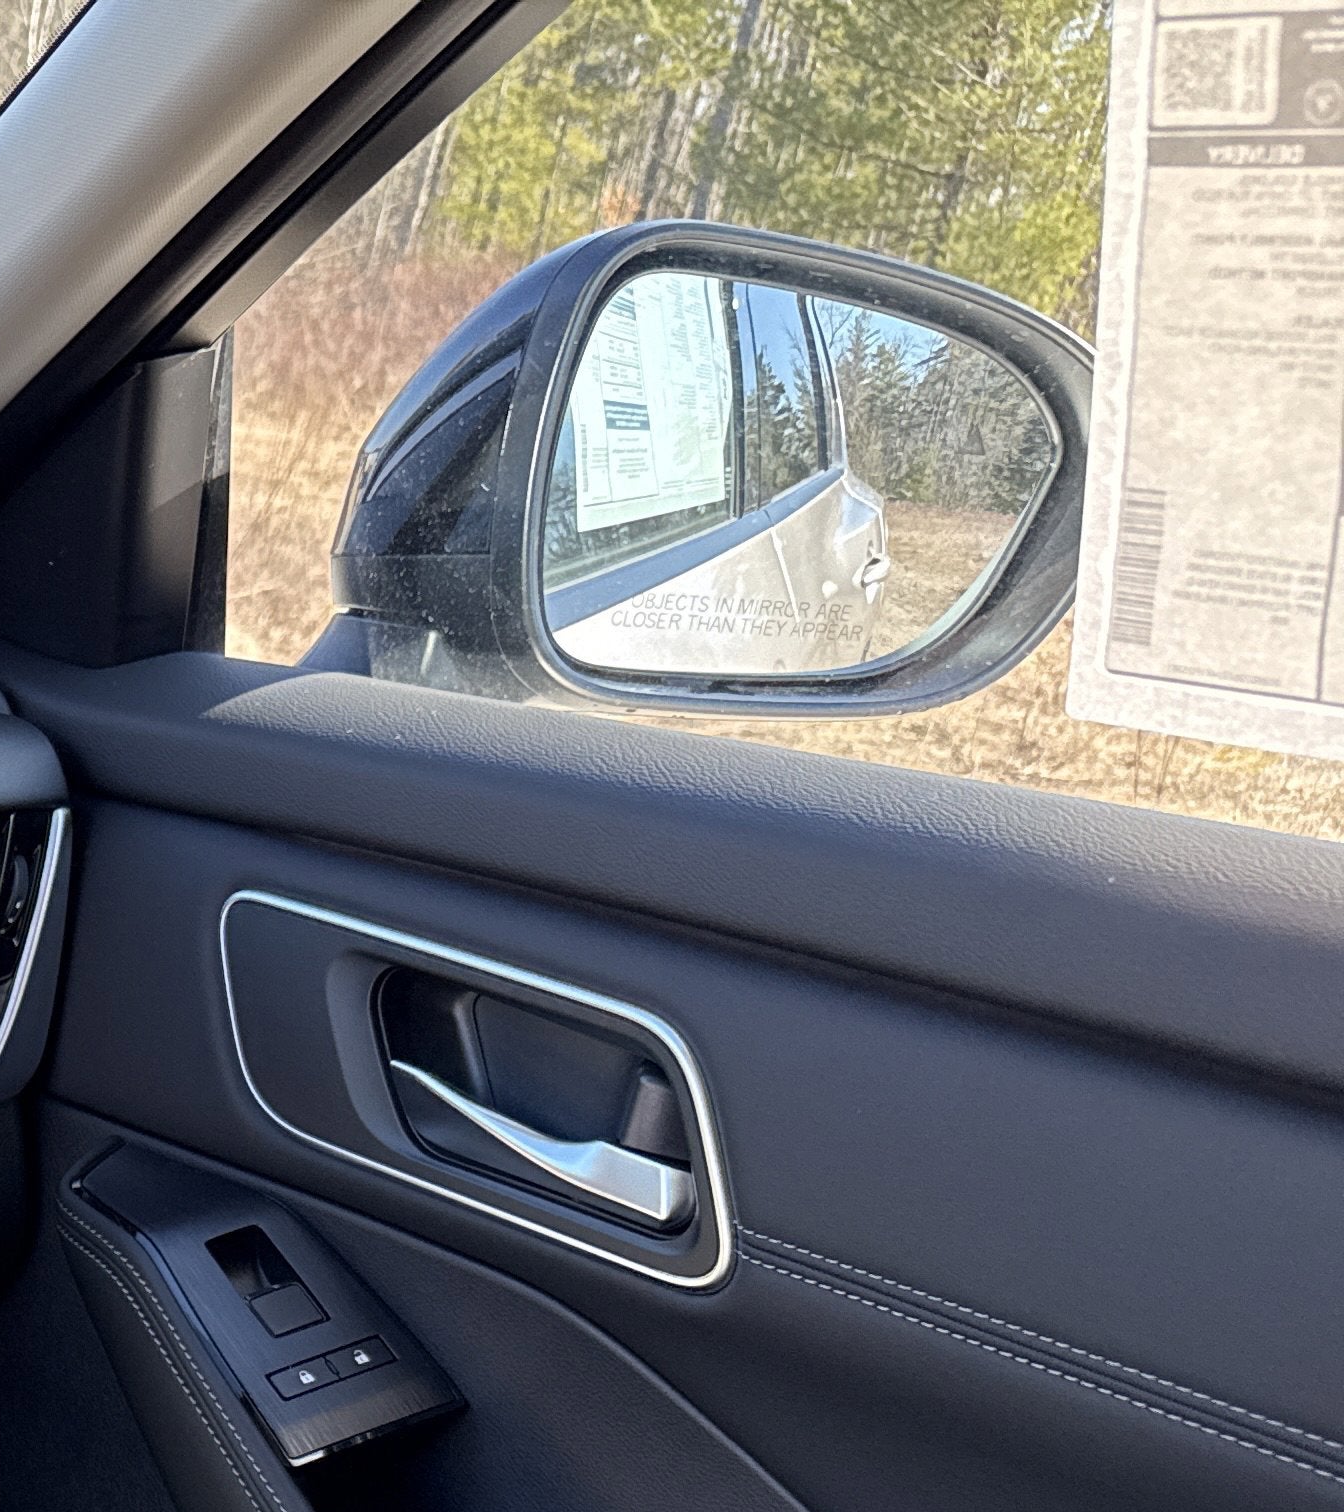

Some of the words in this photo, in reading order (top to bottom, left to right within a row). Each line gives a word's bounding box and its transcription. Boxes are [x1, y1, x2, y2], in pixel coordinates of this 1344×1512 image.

[631, 592, 710, 612] OBJECTS
[714, 596, 735, 614] IN
[736, 598, 809, 619] MIRROR
[815, 603, 854, 622] ARE
[611, 610, 682, 630] CLOSER
[687, 613, 736, 633] THAN
[740, 617, 787, 637] THEY
[790, 621, 863, 641] APPEAR
